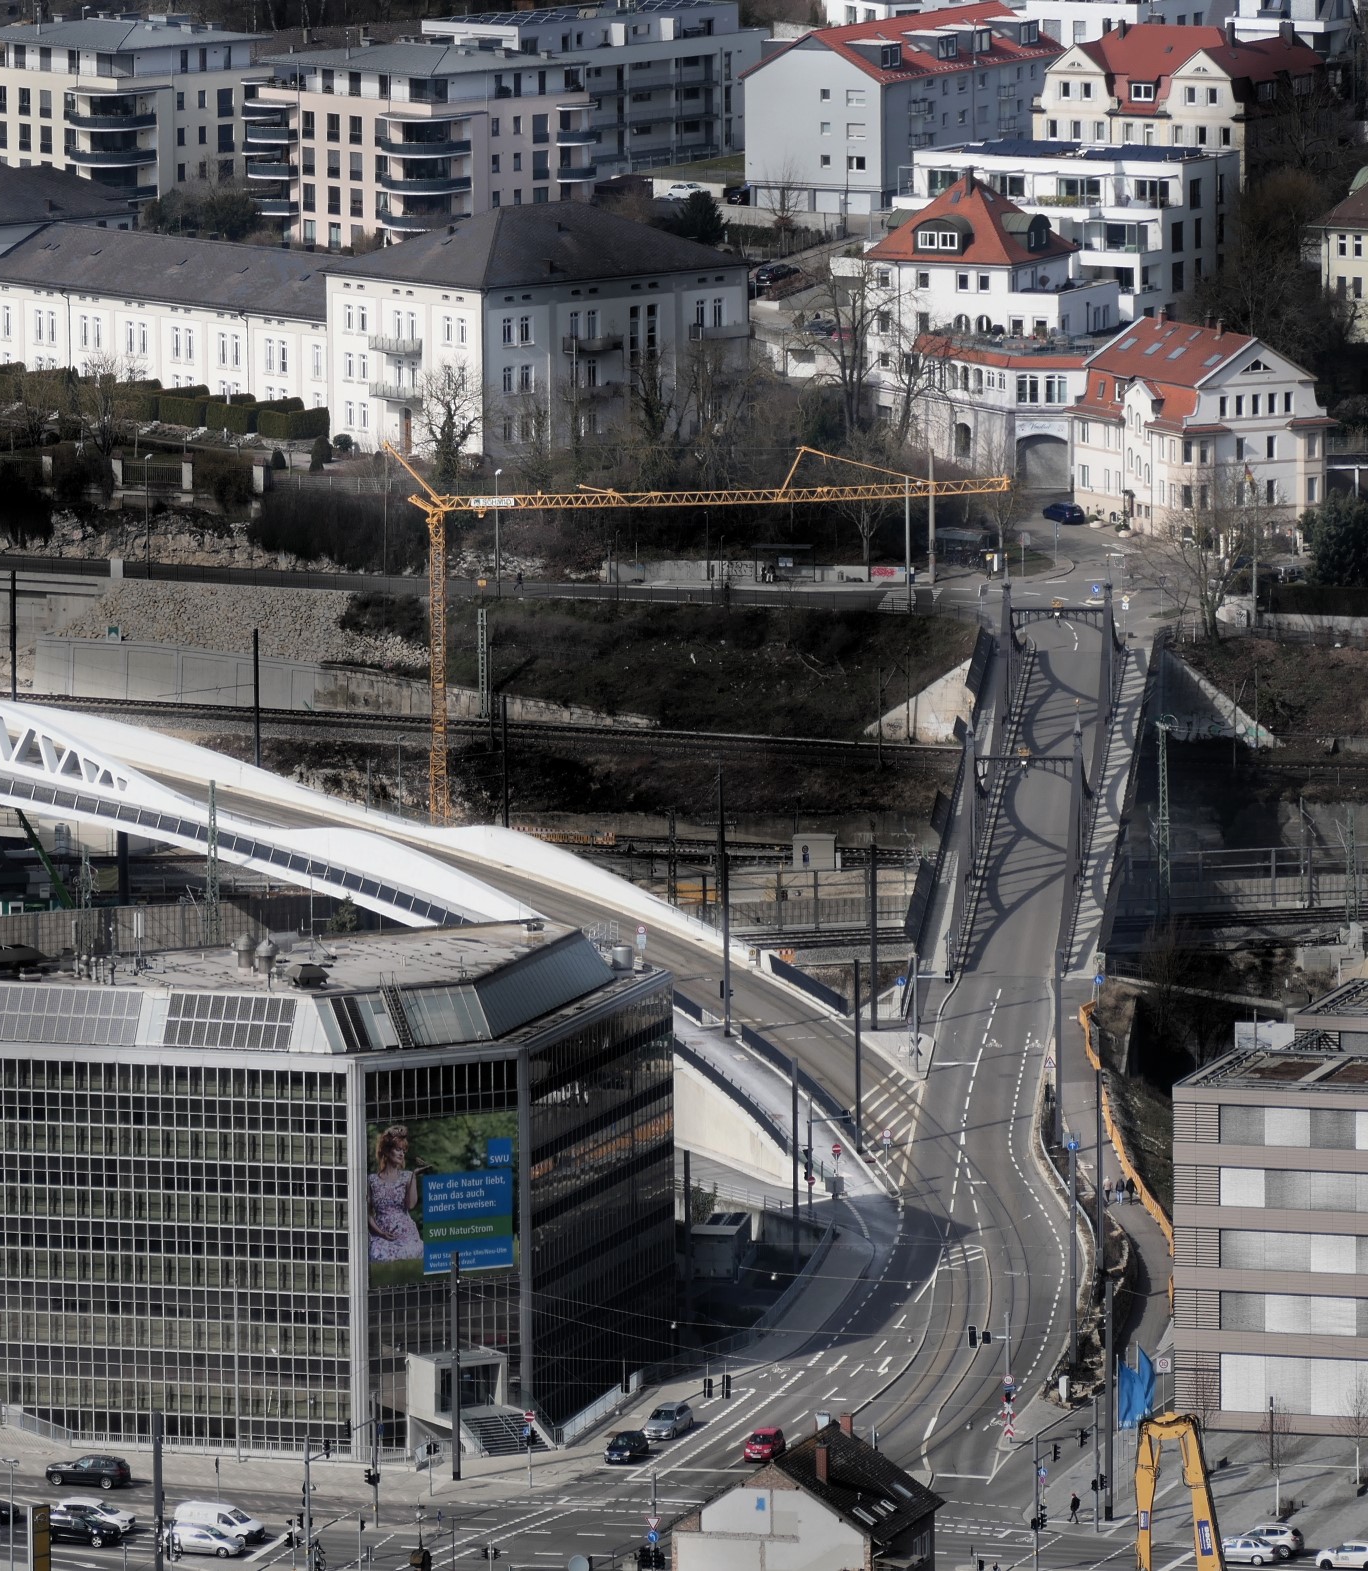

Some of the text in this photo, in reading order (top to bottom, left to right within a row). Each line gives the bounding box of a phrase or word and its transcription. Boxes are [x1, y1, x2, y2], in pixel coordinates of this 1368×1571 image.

[489, 1154, 510, 1164] SWU
[428, 1175, 506, 1191] Wer die Natur liebt,
[428, 1188, 485, 1202] kann das auch
[428, 1199, 497, 1213] anders beweisen:
[429, 1224, 494, 1238] SWU NaturStrom
